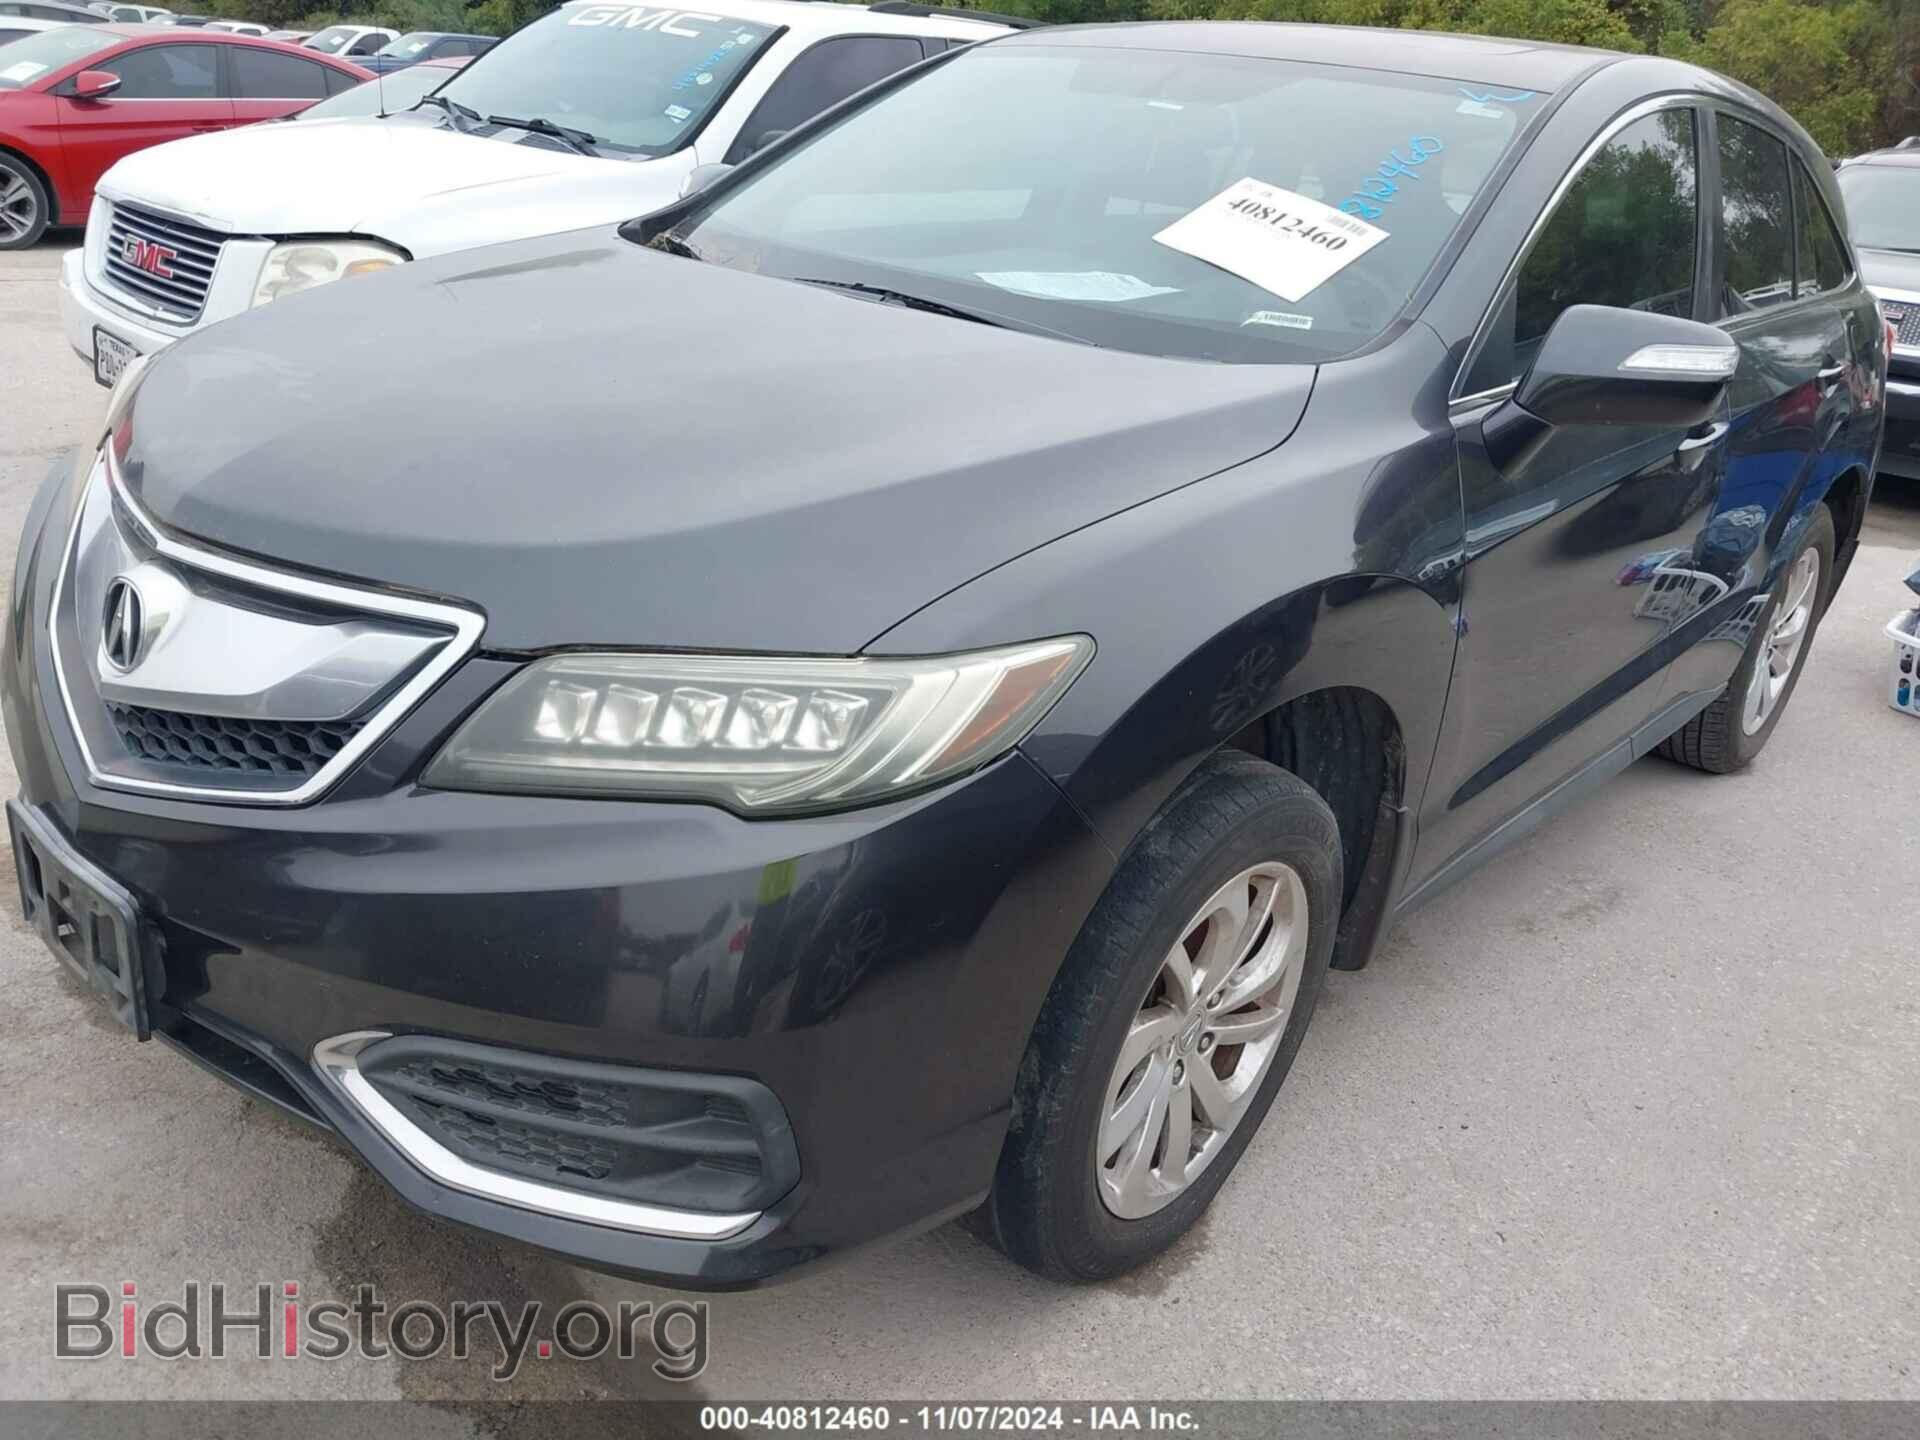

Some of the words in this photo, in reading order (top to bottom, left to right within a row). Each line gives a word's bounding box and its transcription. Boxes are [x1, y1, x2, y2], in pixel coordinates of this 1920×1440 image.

[567, 5, 723, 38] GMC
[1228, 198, 1348, 251] 40812460
[121, 233, 177, 278] GMC
